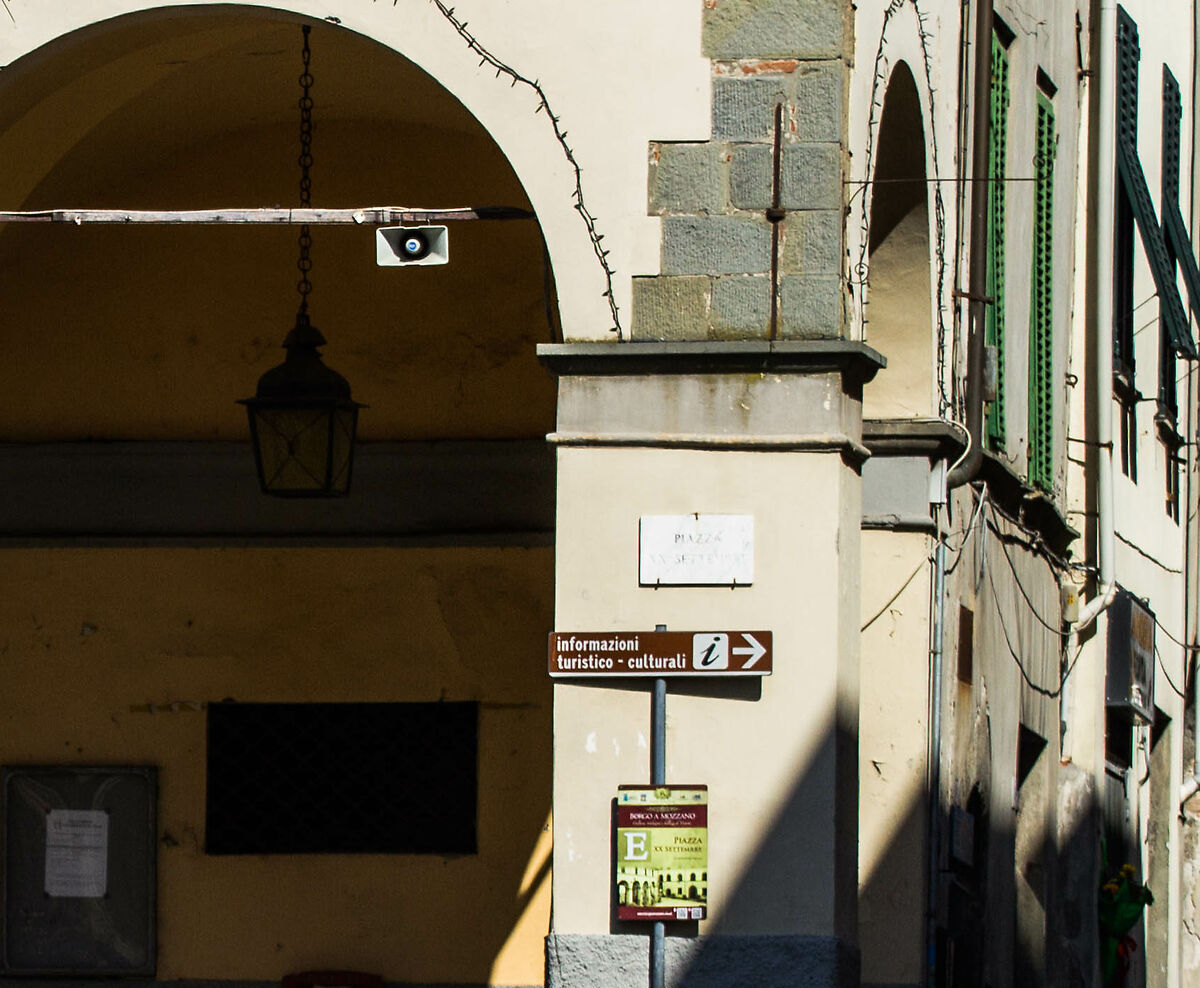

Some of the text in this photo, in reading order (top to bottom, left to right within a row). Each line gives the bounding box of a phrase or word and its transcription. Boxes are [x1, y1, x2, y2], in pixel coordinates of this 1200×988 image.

[674, 533, 723, 544] PIAZZA
[556, 635, 639, 652] informazioni
[556, 654, 614, 670] turistico
[627, 654, 686, 669] culturali
[629, 812, 696, 820] BORGO A MOZZANO
[623, 831, 649, 861] E
[673, 836, 703, 844] PIAZZA
